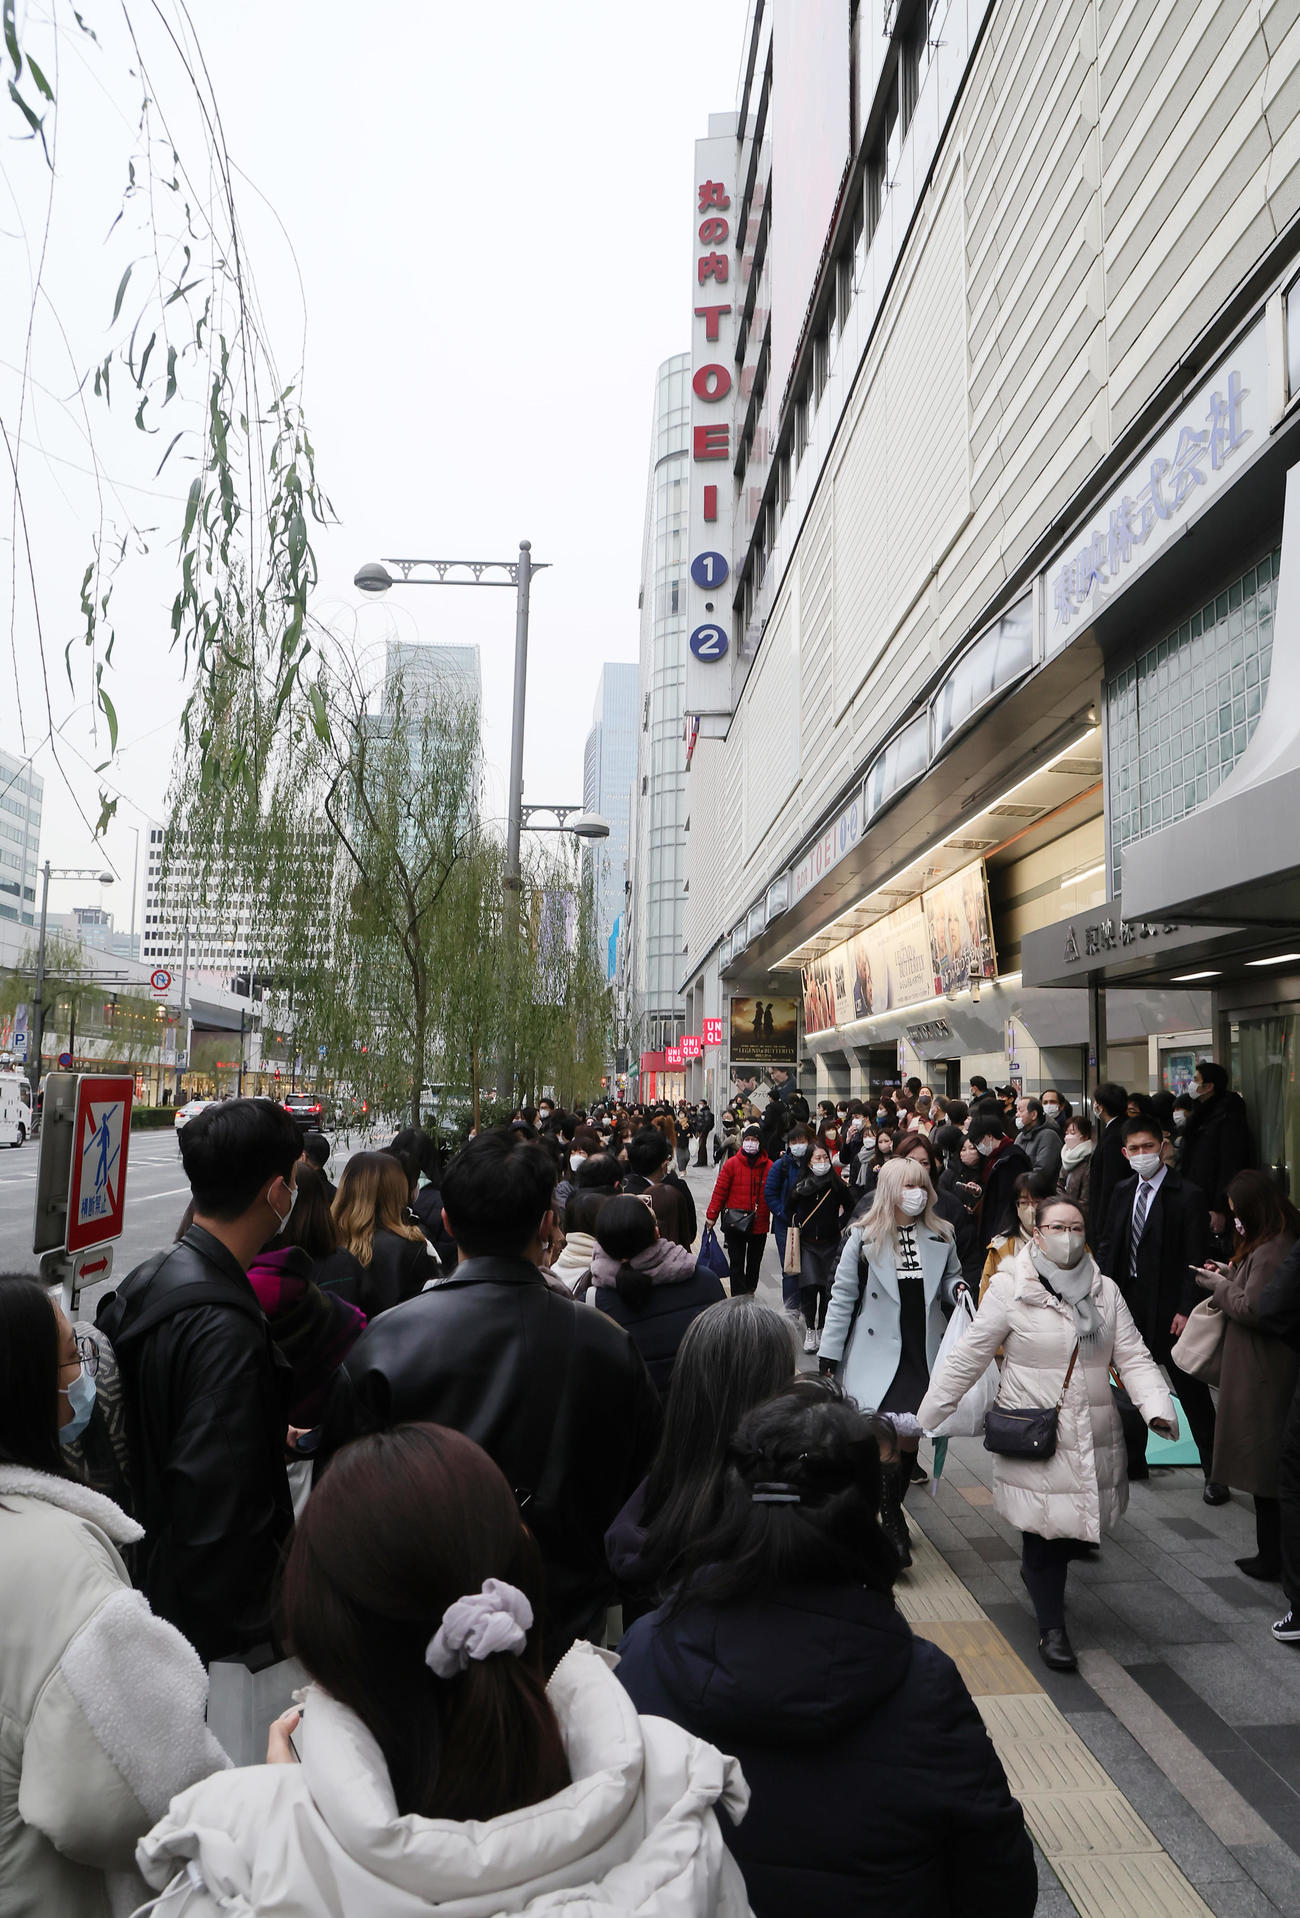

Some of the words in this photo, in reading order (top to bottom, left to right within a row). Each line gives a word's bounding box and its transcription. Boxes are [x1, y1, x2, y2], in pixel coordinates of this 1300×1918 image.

[698, 179, 731, 286] 丸の内
[692, 303, 732, 522] TOEI
[809, 826, 837, 882] TOEI
[707, 1021, 722, 1031] UN
[15, 1033, 25, 1046] P
[683, 1038, 698, 1046] UNI
[707, 1032, 721, 1043] QL
[683, 1047, 699, 1055] QLO
[178, 1053, 185, 1062] P
